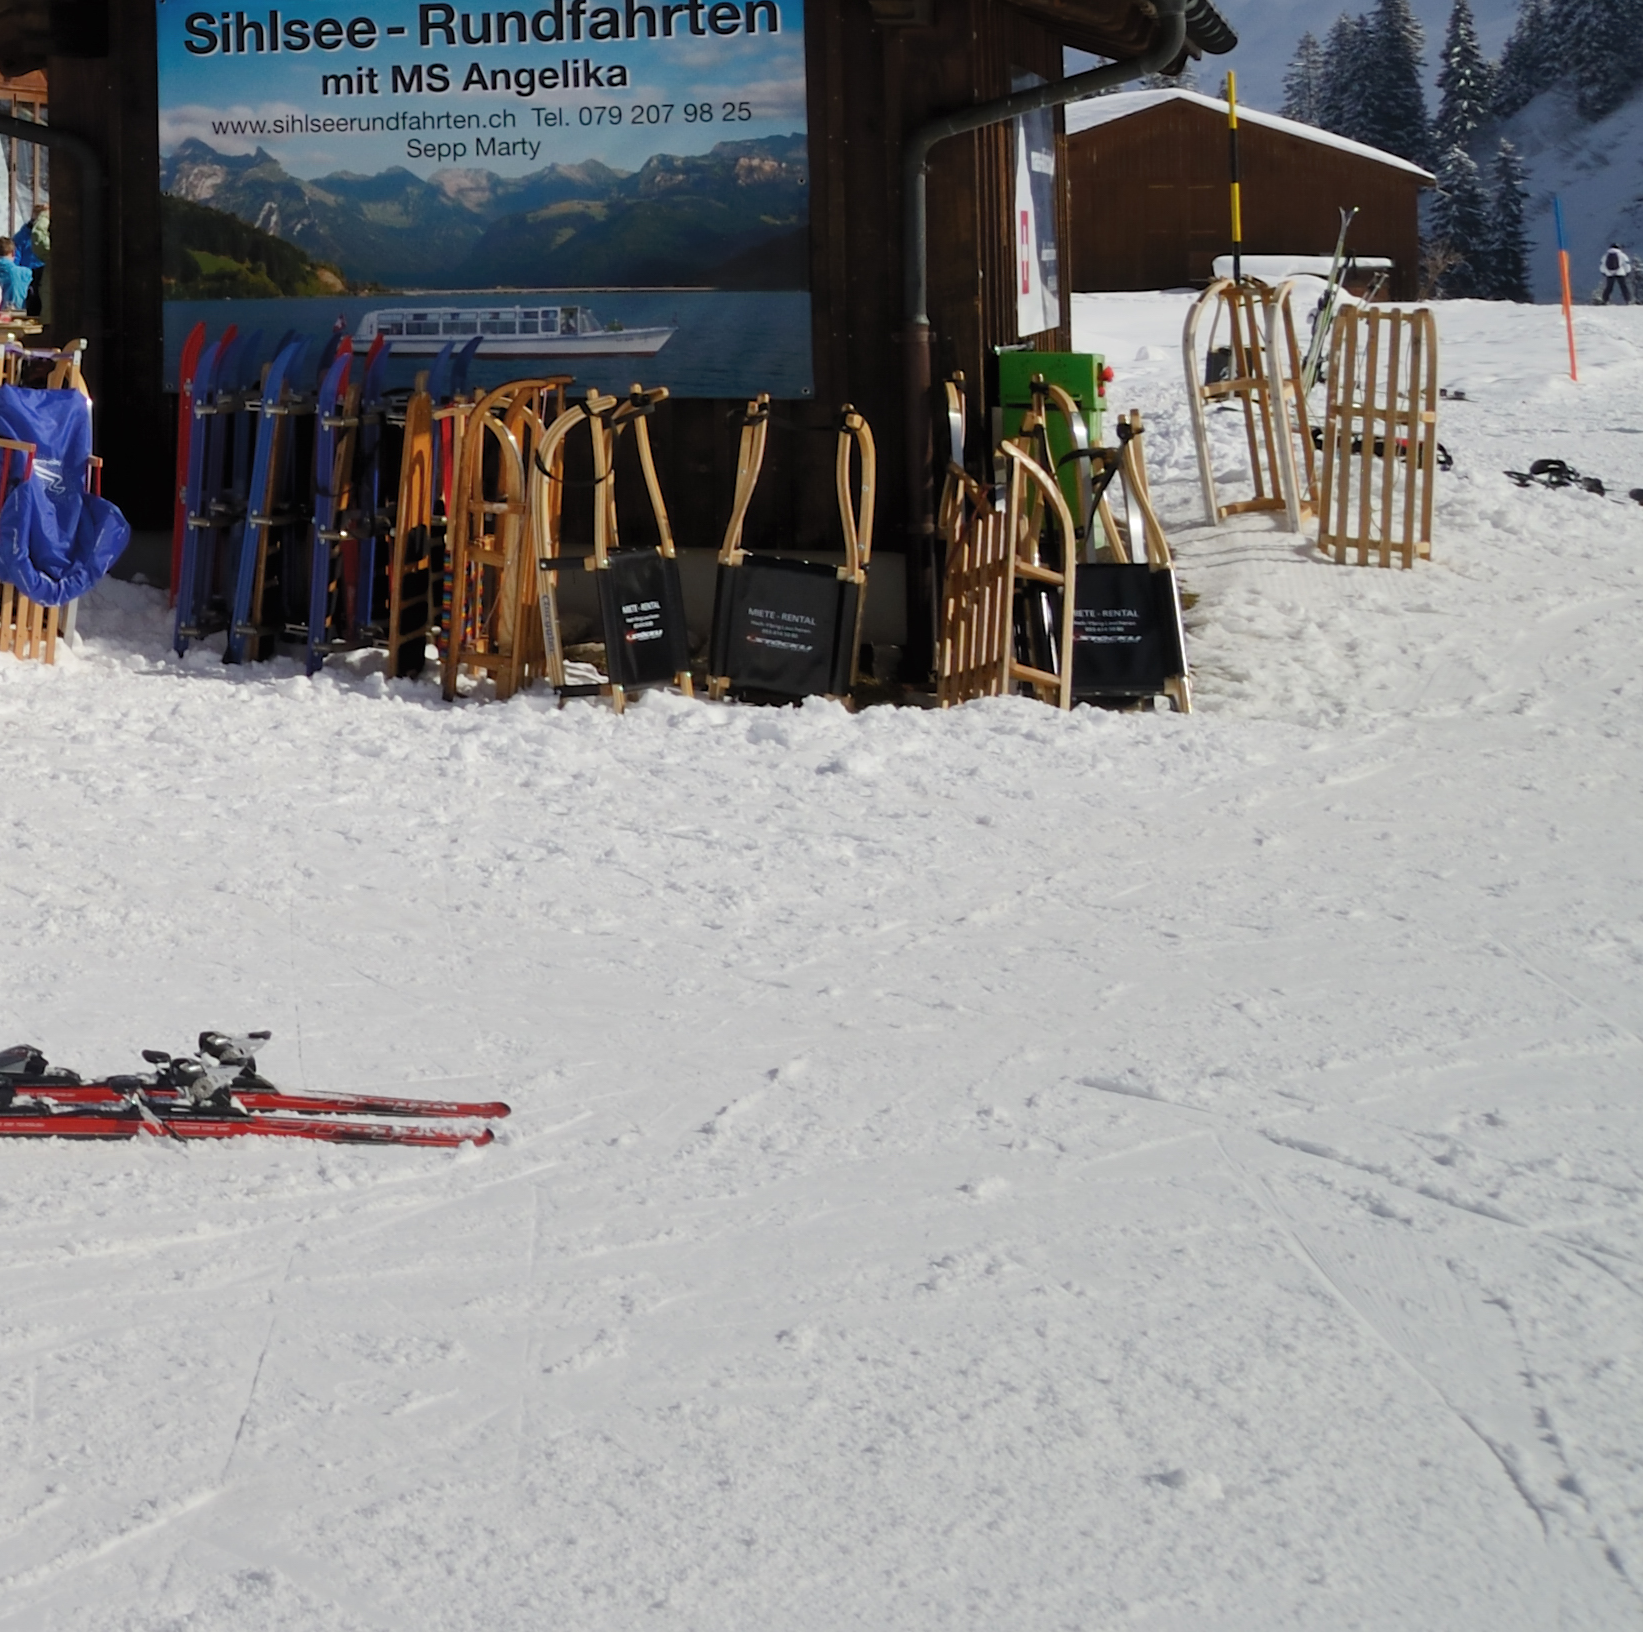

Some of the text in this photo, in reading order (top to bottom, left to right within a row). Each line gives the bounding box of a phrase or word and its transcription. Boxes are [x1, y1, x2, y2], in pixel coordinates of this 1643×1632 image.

[184, 10, 377, 55] Sihlsee
[322, 59, 628, 97] mit MS Angelika
[211, 101, 752, 135] www.sihlseerundfahrten.ch Tel. 079 207 98 25
[406, 136, 541, 162] Sepp Marty
[748, 607, 776, 620] MIETE
[781, 612, 816, 625] RENTAL
[1074, 609, 1095, 618] IETE
[1102, 609, 1139, 618] RENTAL
